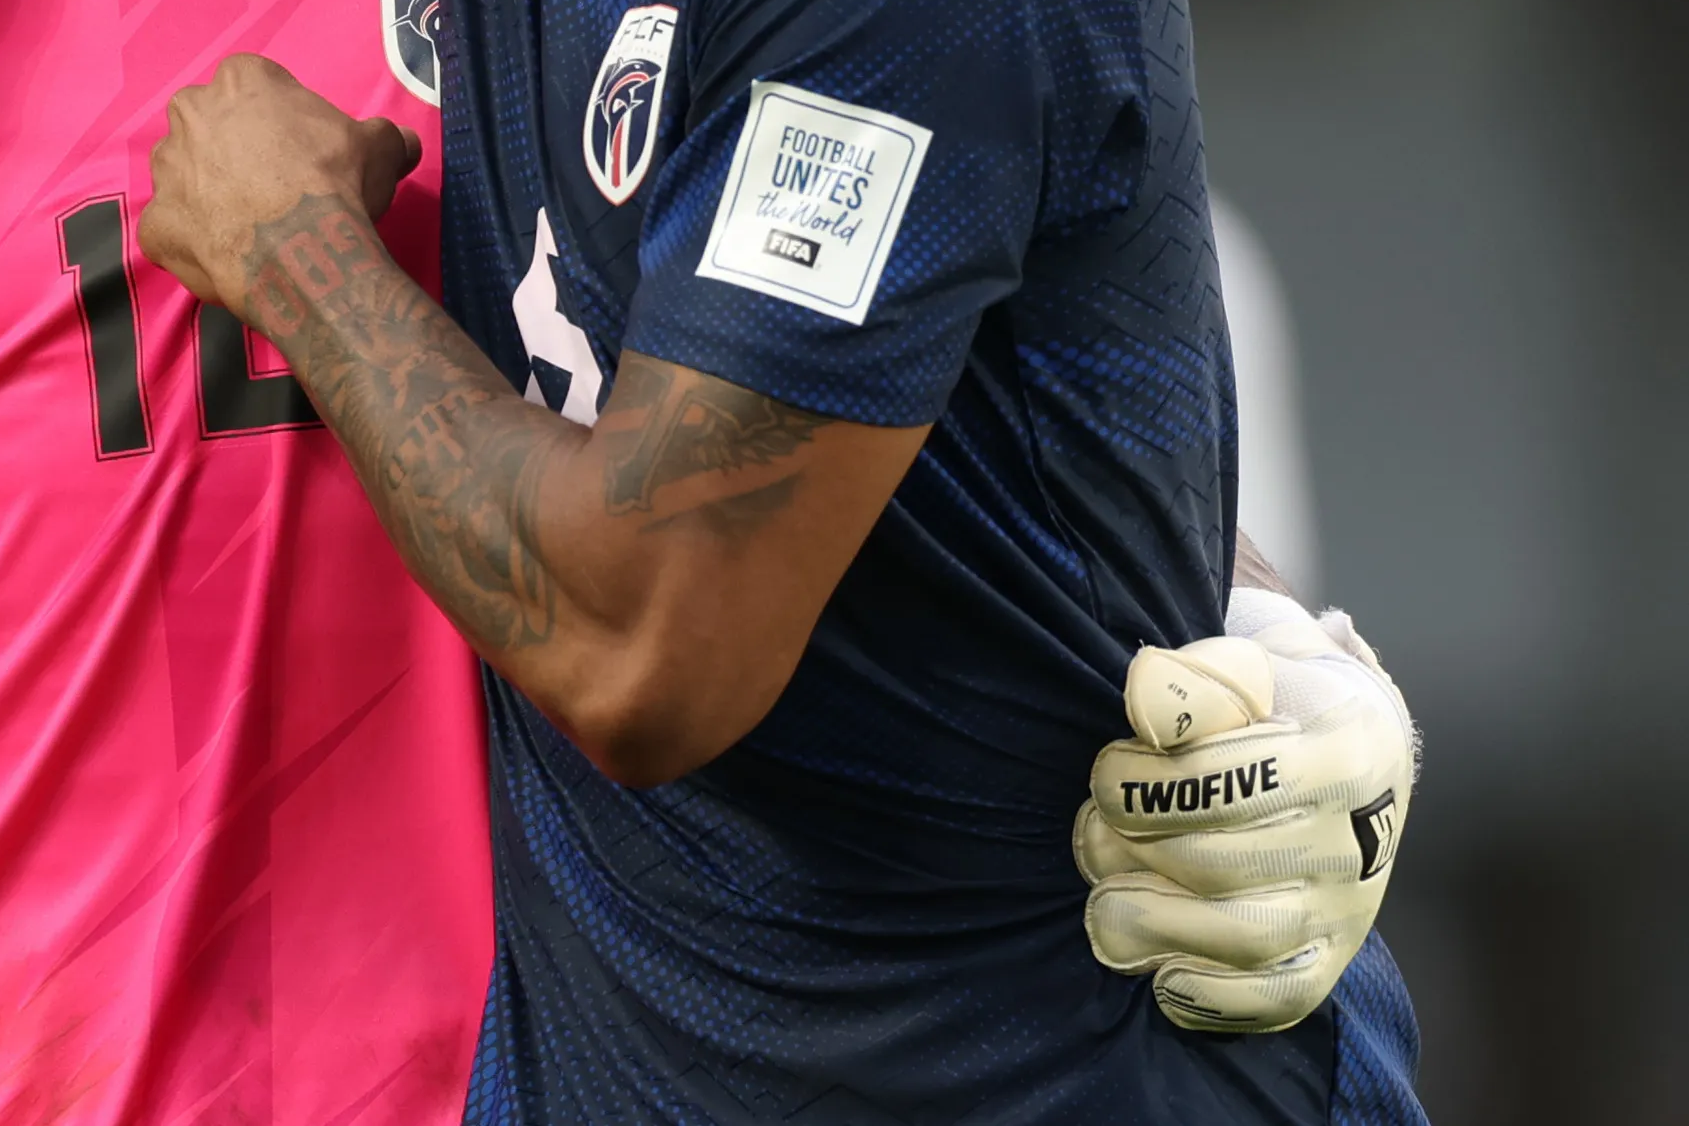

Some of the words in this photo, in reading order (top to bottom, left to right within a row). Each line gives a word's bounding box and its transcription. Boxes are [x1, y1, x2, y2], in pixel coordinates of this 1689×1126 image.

[617, 15, 675, 46] FCF
[780, 125, 877, 176] FOOTBALL
[771, 152, 870, 211] UNITES
[755, 190, 789, 220] the
[788, 199, 864, 247] World
[767, 233, 812, 263] FIFA
[1120, 756, 1280, 815] TWOFIVE
